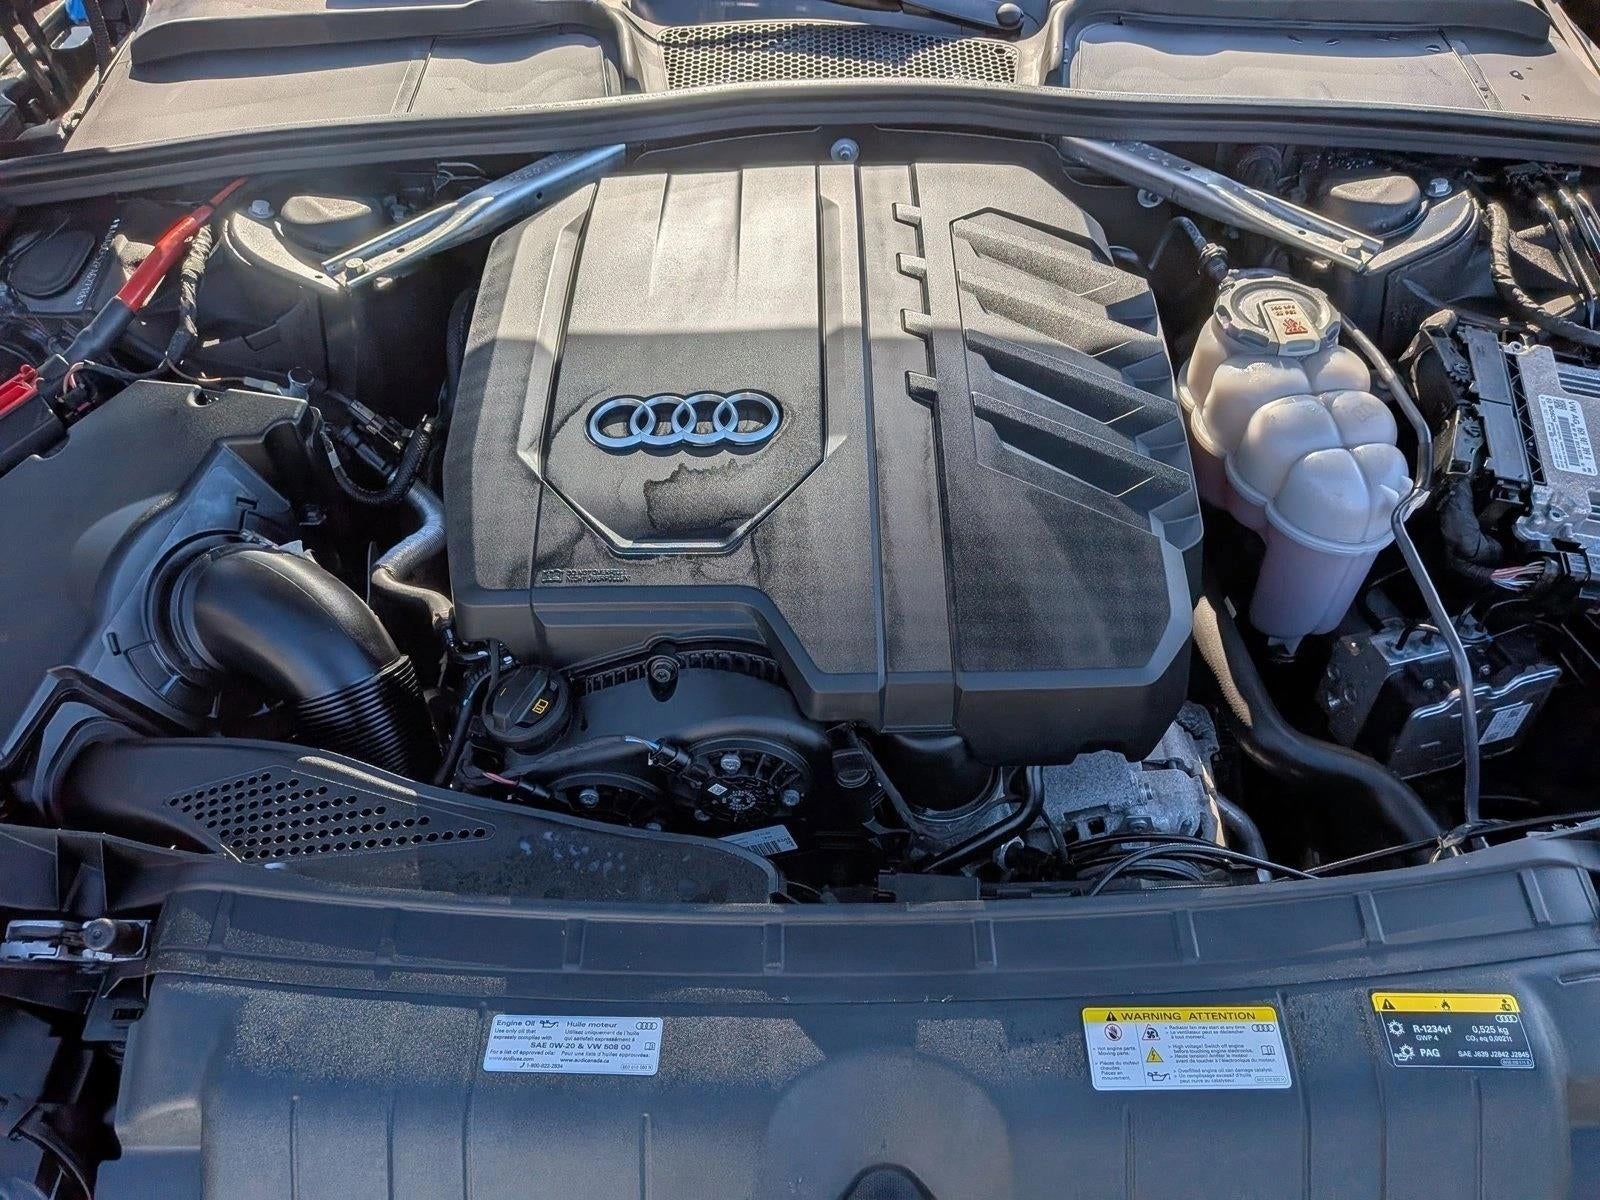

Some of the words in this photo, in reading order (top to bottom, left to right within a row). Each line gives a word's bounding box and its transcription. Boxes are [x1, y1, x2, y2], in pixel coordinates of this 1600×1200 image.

[1188, 1012, 1256, 1020] ATTENTION
[1412, 1025, 1452, 1034] R-1234yf
[1472, 1026, 1496, 1034] 0,525
[1497, 1026, 1509, 1035] kg
[1420, 1048, 1440, 1057] PAG
